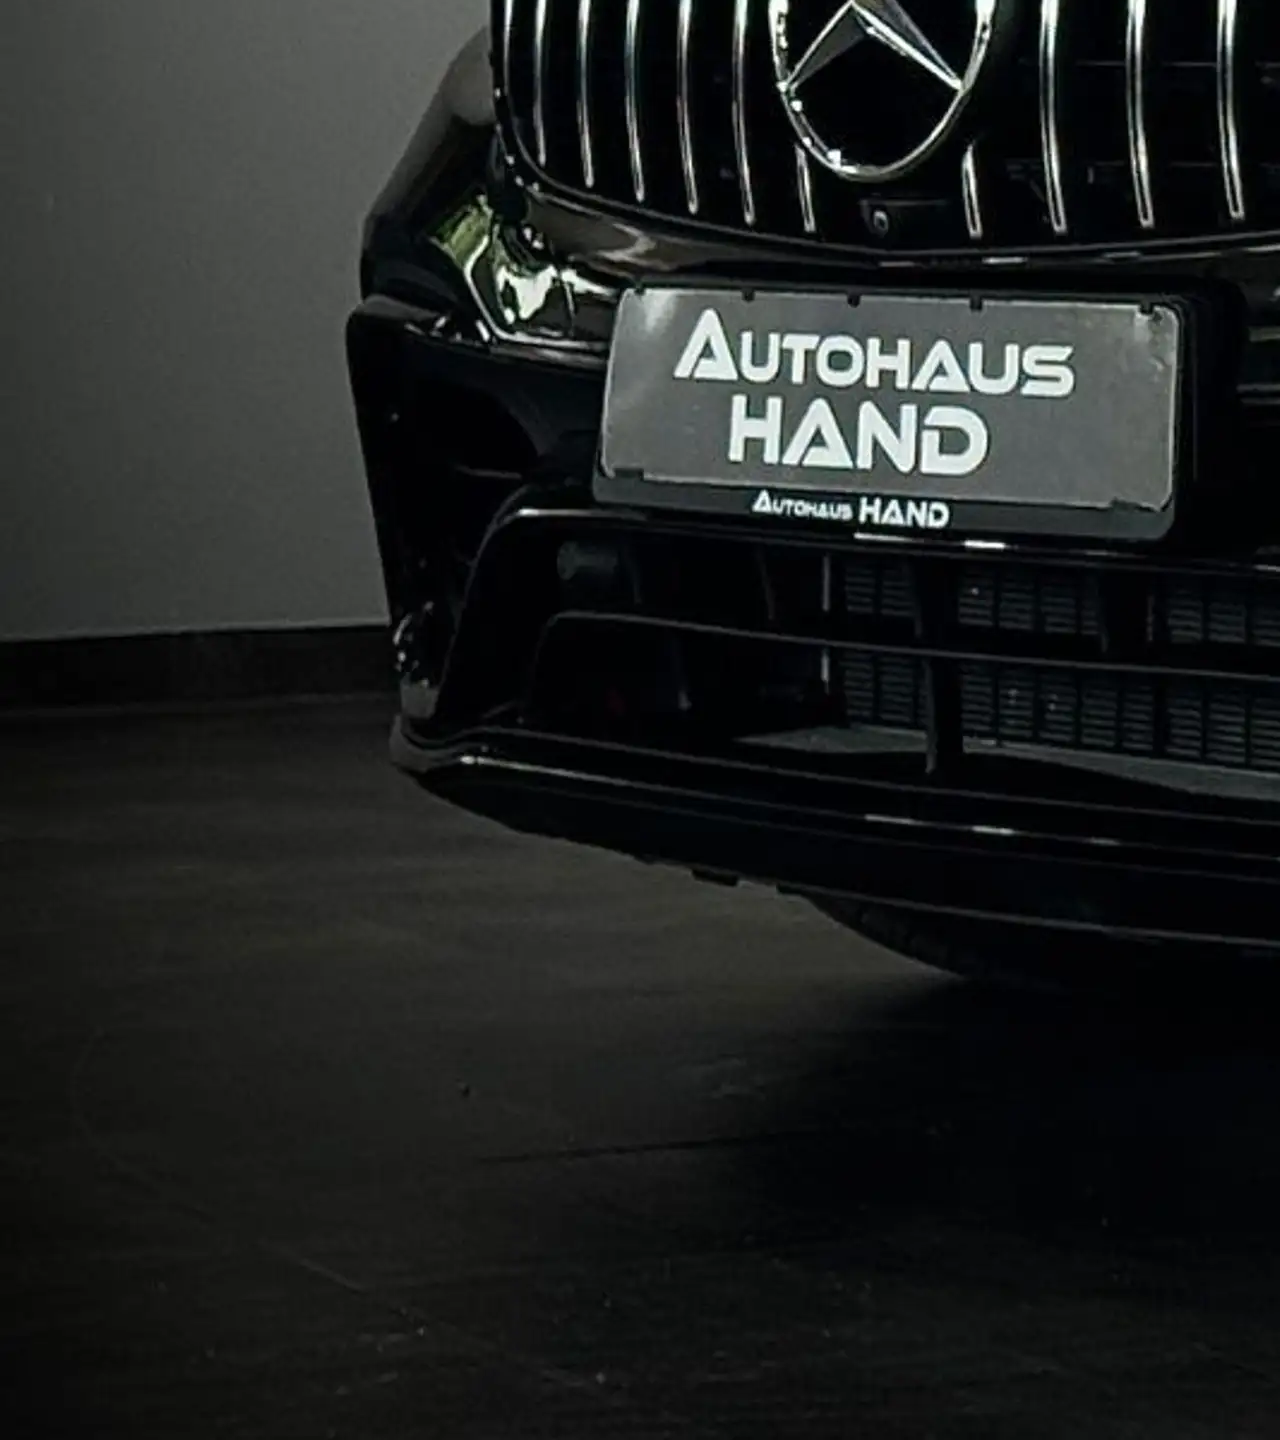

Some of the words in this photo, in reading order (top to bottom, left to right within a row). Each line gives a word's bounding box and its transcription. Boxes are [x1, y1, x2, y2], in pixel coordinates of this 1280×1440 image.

[674, 309, 1073, 396] AUTOHAUS
[729, 395, 987, 474] HAND
[752, 489, 853, 521] AUTOHAUS
[858, 496, 950, 528] HAND
